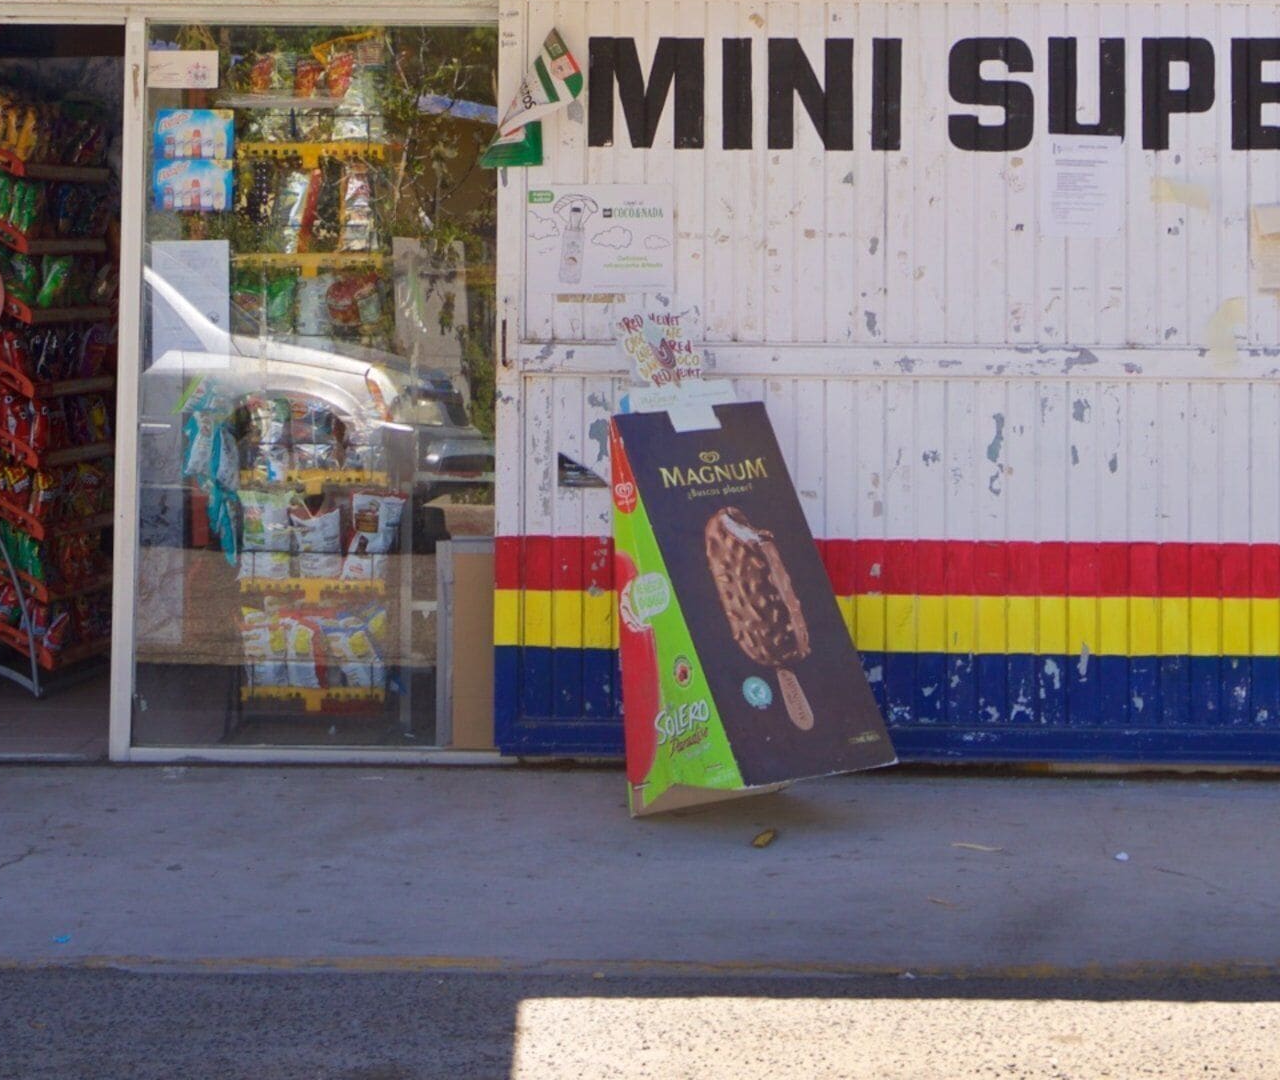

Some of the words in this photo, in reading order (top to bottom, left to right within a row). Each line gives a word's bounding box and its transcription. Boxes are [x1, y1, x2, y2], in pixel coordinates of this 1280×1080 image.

[588, 37, 903, 150] MINI
[659, 457, 769, 489] MAGNUM
[654, 698, 710, 745] SOLERO
